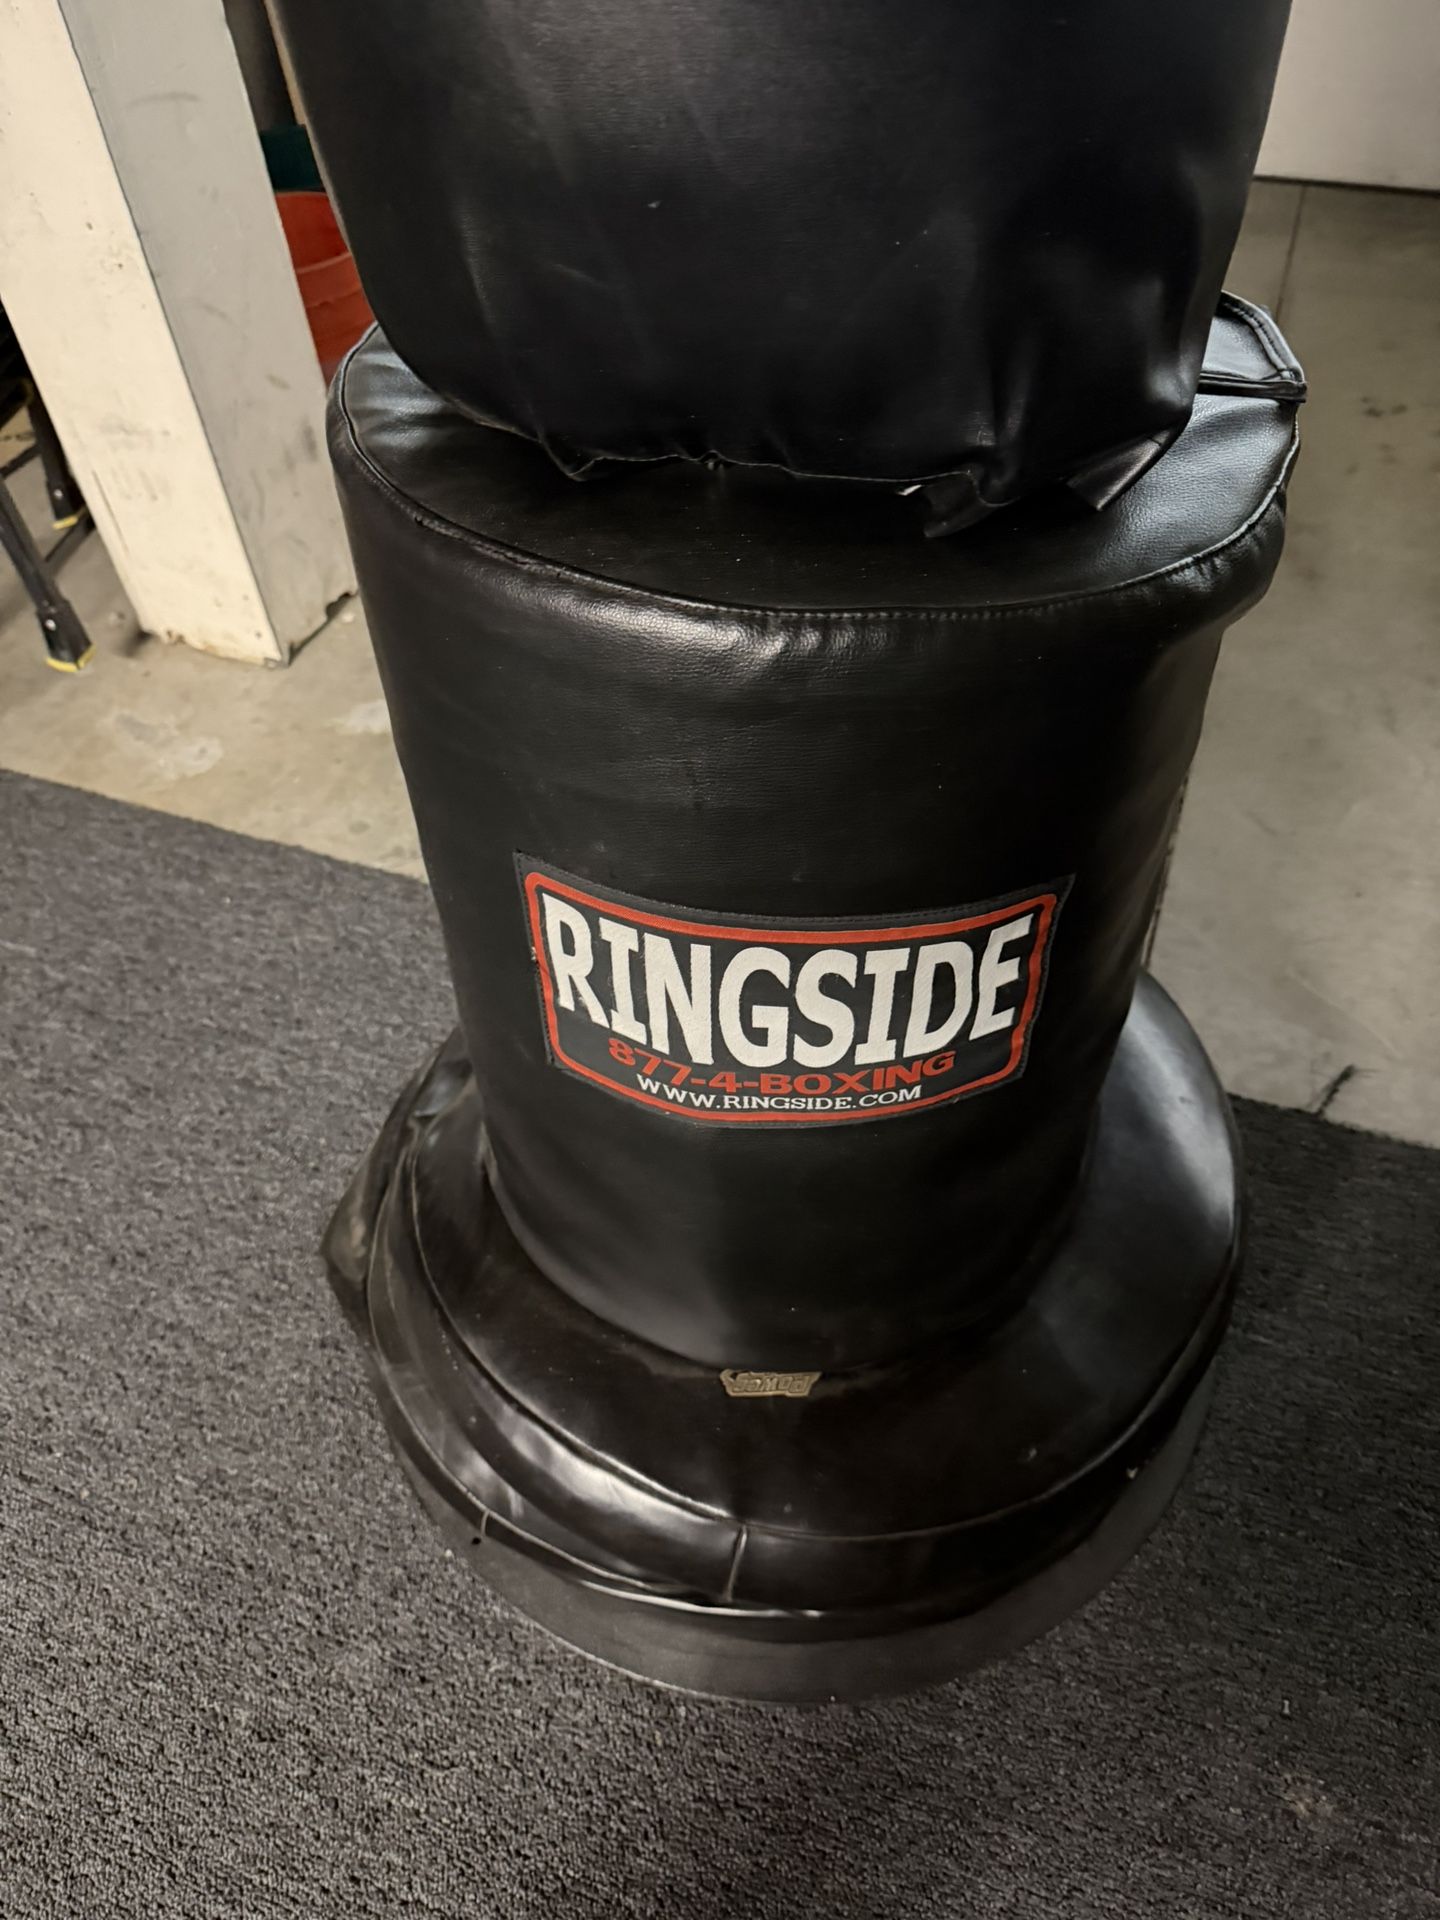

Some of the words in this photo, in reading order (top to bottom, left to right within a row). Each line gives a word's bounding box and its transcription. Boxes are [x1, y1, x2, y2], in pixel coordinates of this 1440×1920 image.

[542, 893, 1034, 1068] RINGSIDE
[608, 1039, 956, 1095] 877-4-BOXING
[636, 1075, 923, 1111] WWW.RINGSIDE.COM
